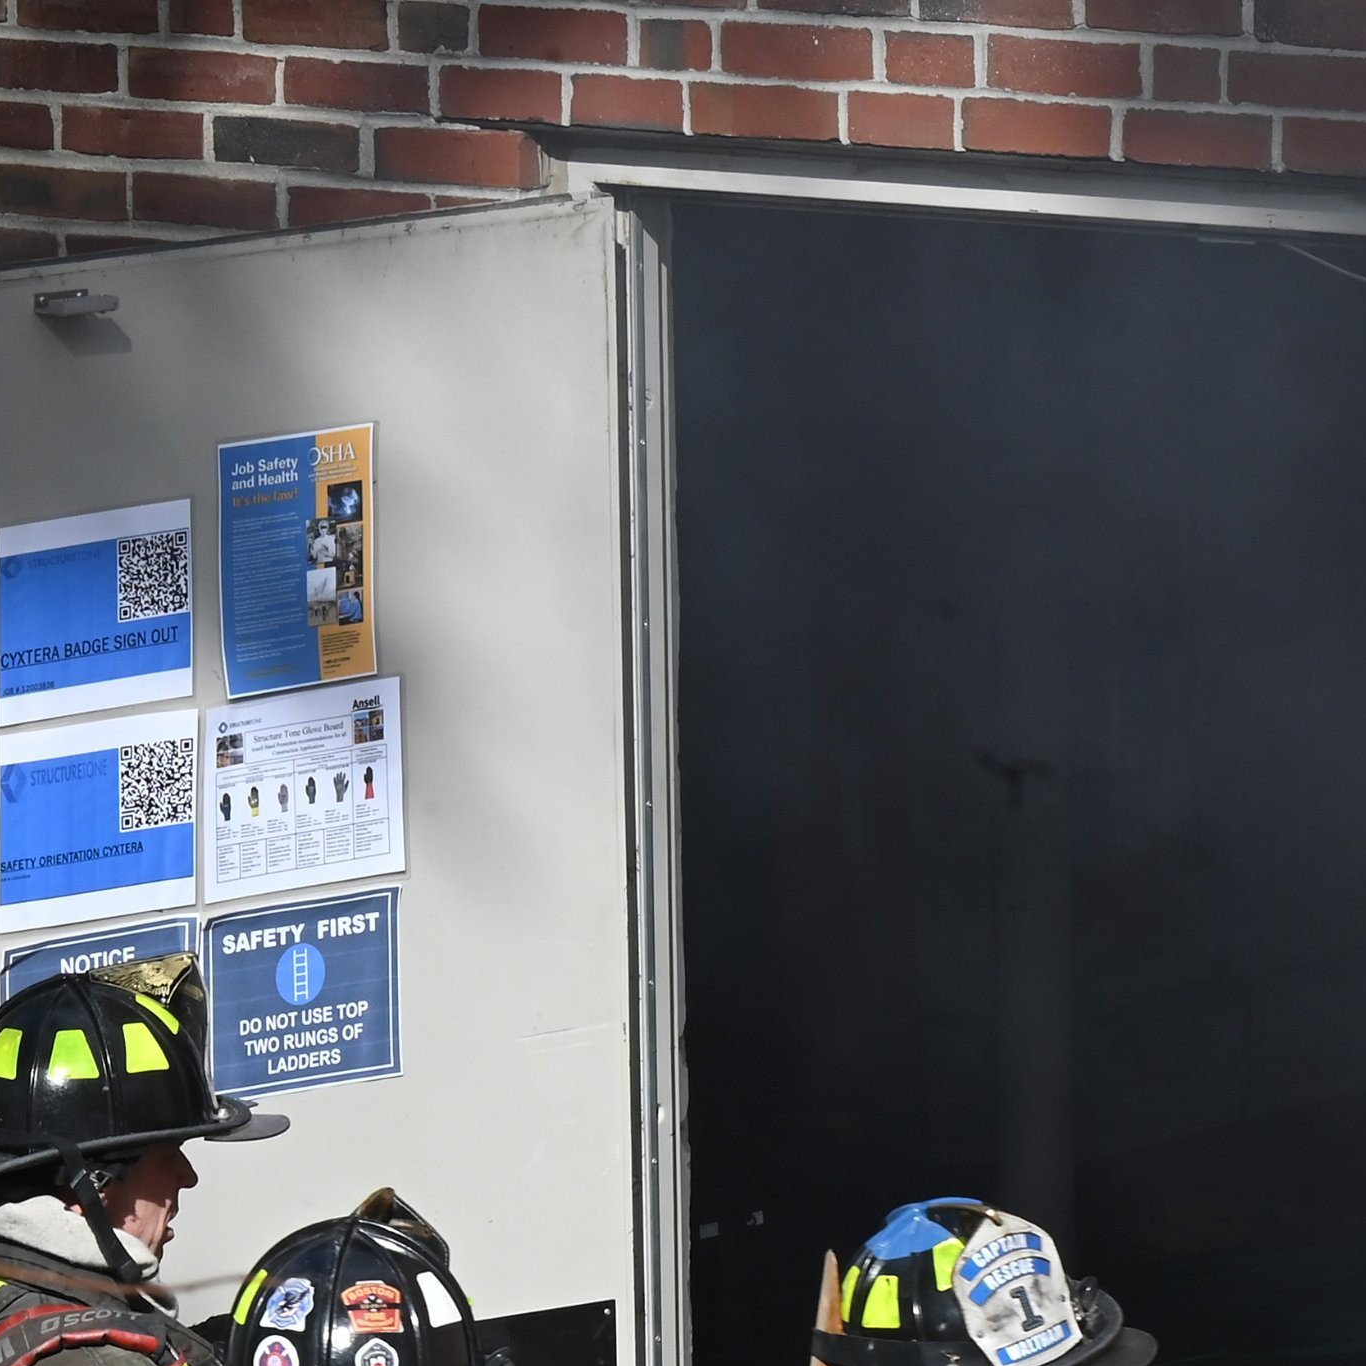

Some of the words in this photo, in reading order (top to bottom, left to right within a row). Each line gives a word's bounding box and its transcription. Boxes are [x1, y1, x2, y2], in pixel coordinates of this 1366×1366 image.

[232, 463, 254, 476] Job
[258, 457, 298, 473] Safety
[309, 442, 356, 466] OSHA
[232, 476, 254, 490] and
[258, 471, 298, 487] Health
[253, 491, 270, 505] the
[273, 487, 299, 502] law!
[1, 646, 59, 669] CYXTERA
[64, 637, 109, 659] BADGE
[113, 630, 146, 650] SIGN
[151, 626, 179, 643] OUT
[352, 695, 380, 710] Ansell
[254, 731, 282, 744] Structure
[284, 729, 301, 740] Tone
[302, 725, 322, 737] Glove
[324, 721, 344, 733] Board
[0, 857, 36, 873] SAFETY
[39, 848, 100, 868] ORIENTATION
[102, 841, 144, 858] CYXTERA
[222, 923, 305, 955] SAFETY
[317, 912, 380, 940] FIRST
[239, 1017, 262, 1036] DO
[265, 1012, 298, 1032] NOT
[301, 1006, 333, 1026] USE
[337, 1000, 369, 1020] TOP
[244, 1036, 280, 1057] TWO
[283, 1027, 338, 1051] RUNGS
[342, 1023, 364, 1041] OF
[268, 1048, 342, 1075] LADDERS
[971, 1233, 1028, 1268] CAPTAIN
[983, 1258, 1035, 1291] RESCUE
[1009, 1286, 1045, 1332] 1
[1005, 1324, 1065, 1361] WALTHAM
